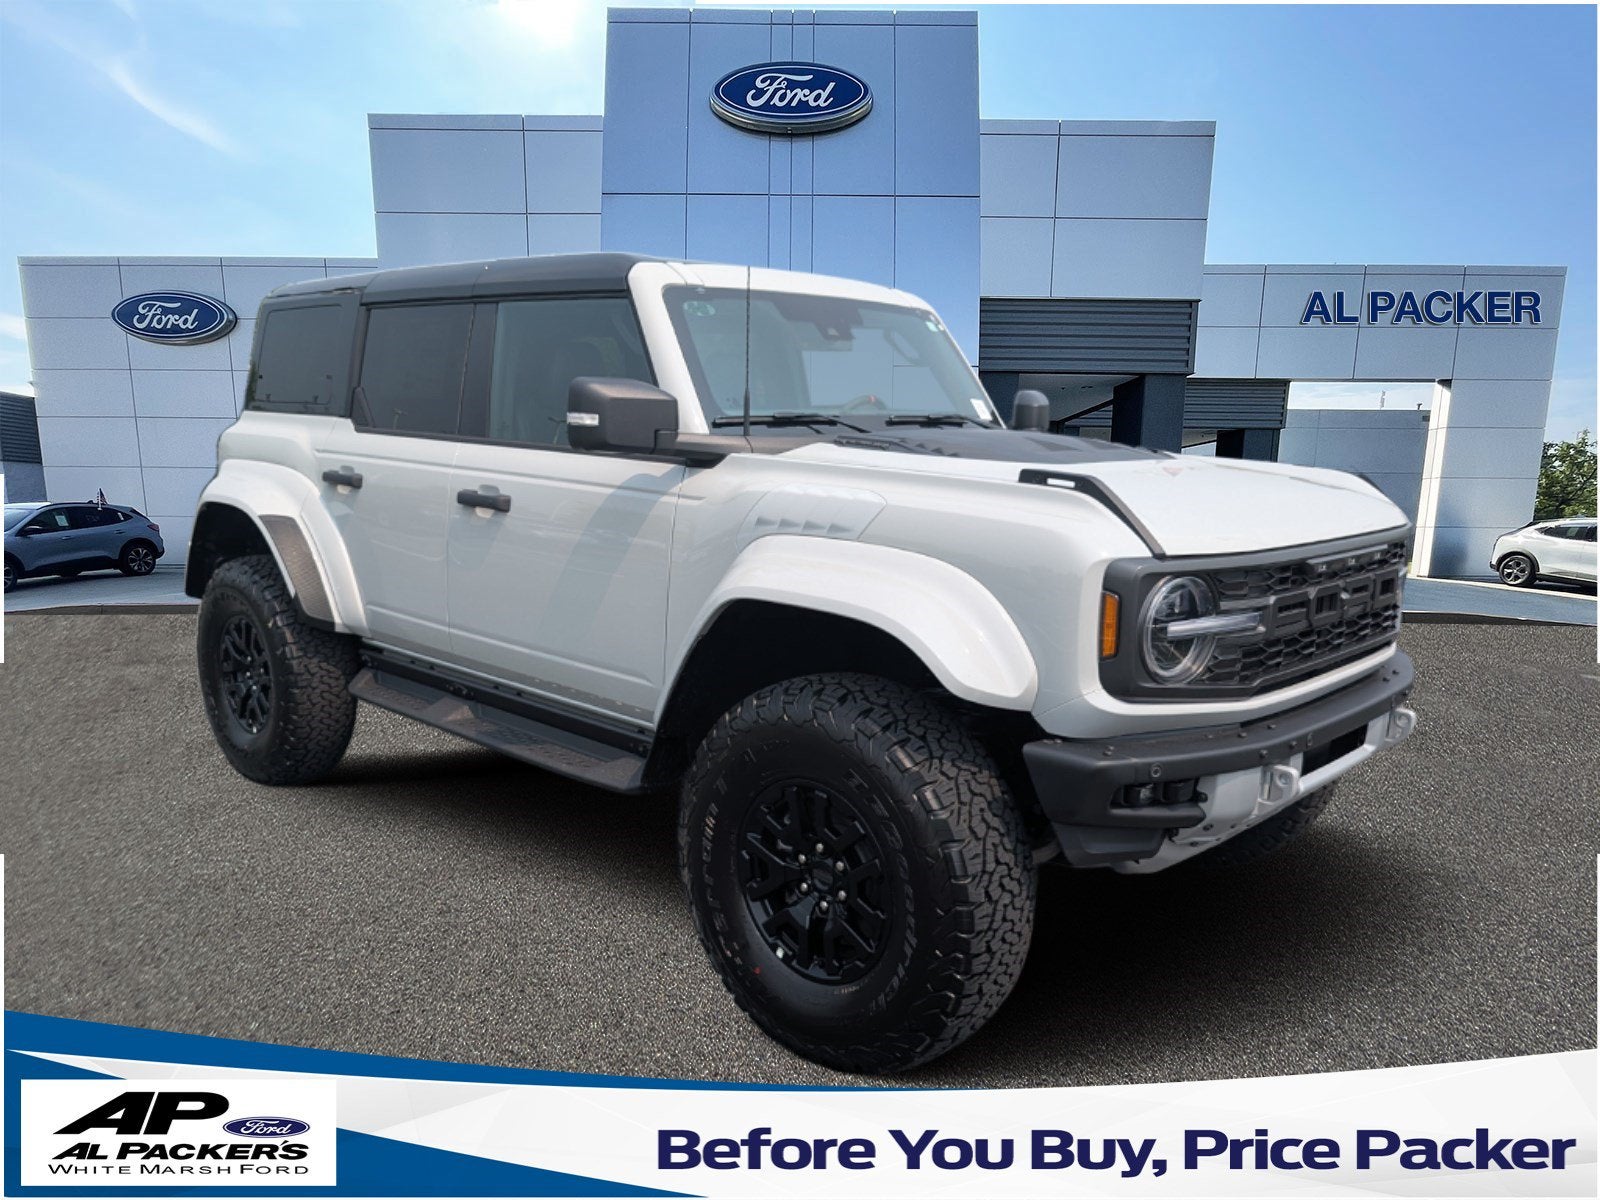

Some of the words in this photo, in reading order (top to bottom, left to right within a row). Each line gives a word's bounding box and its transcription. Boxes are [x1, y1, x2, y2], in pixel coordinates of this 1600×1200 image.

[746, 73, 836, 107] Ford
[133, 301, 198, 329] Ford
[1302, 291, 1360, 324] AL
[1368, 290, 1541, 325] PACKER
